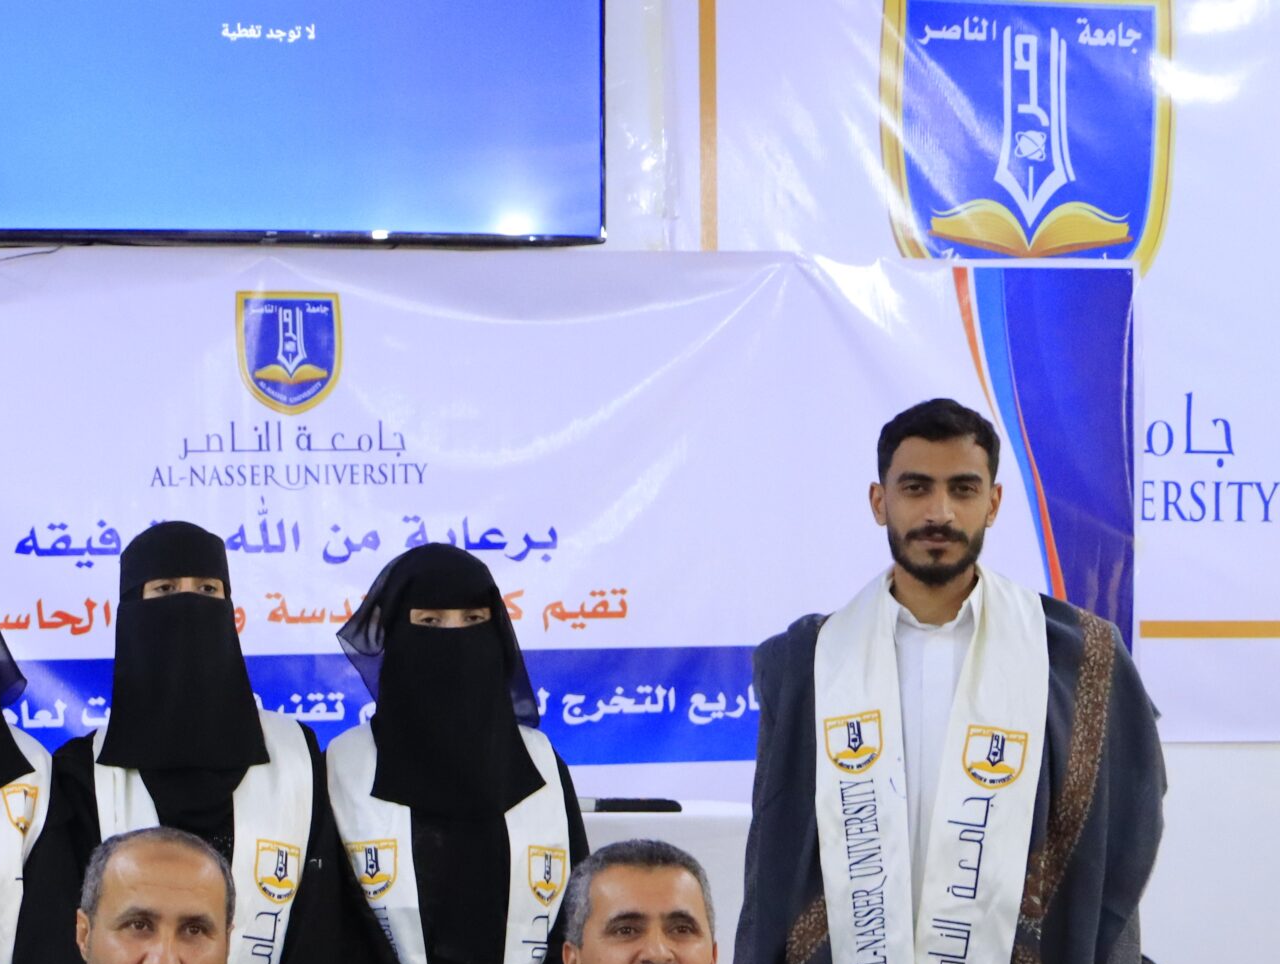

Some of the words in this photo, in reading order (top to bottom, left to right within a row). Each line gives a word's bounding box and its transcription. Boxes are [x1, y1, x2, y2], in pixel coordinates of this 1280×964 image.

[221, 22, 262, 42] تغطية
[266, 25, 302, 43] توجد
[306, 23, 316, 40] لا
[918, 15, 997, 45] الناصر
[1074, 16, 1142, 54] جامعة
[178, 420, 283, 460] الناصر
[296, 420, 407, 458] جامعة
[1143, 391, 1235, 468] جام
[150, 464, 307, 491] AL-NASSER
[285, 462, 429, 487] UNIVERSITY
[1140, 480, 1280, 523] ERSITY
[322, 523, 382, 565] من
[542, 588, 629, 633] تقيم
[561, 684, 676, 726] التخرج
[688, 683, 761, 726] اريع
[839, 777, 883, 880] UNIVERSITY
[947, 793, 997, 900] جامعة
